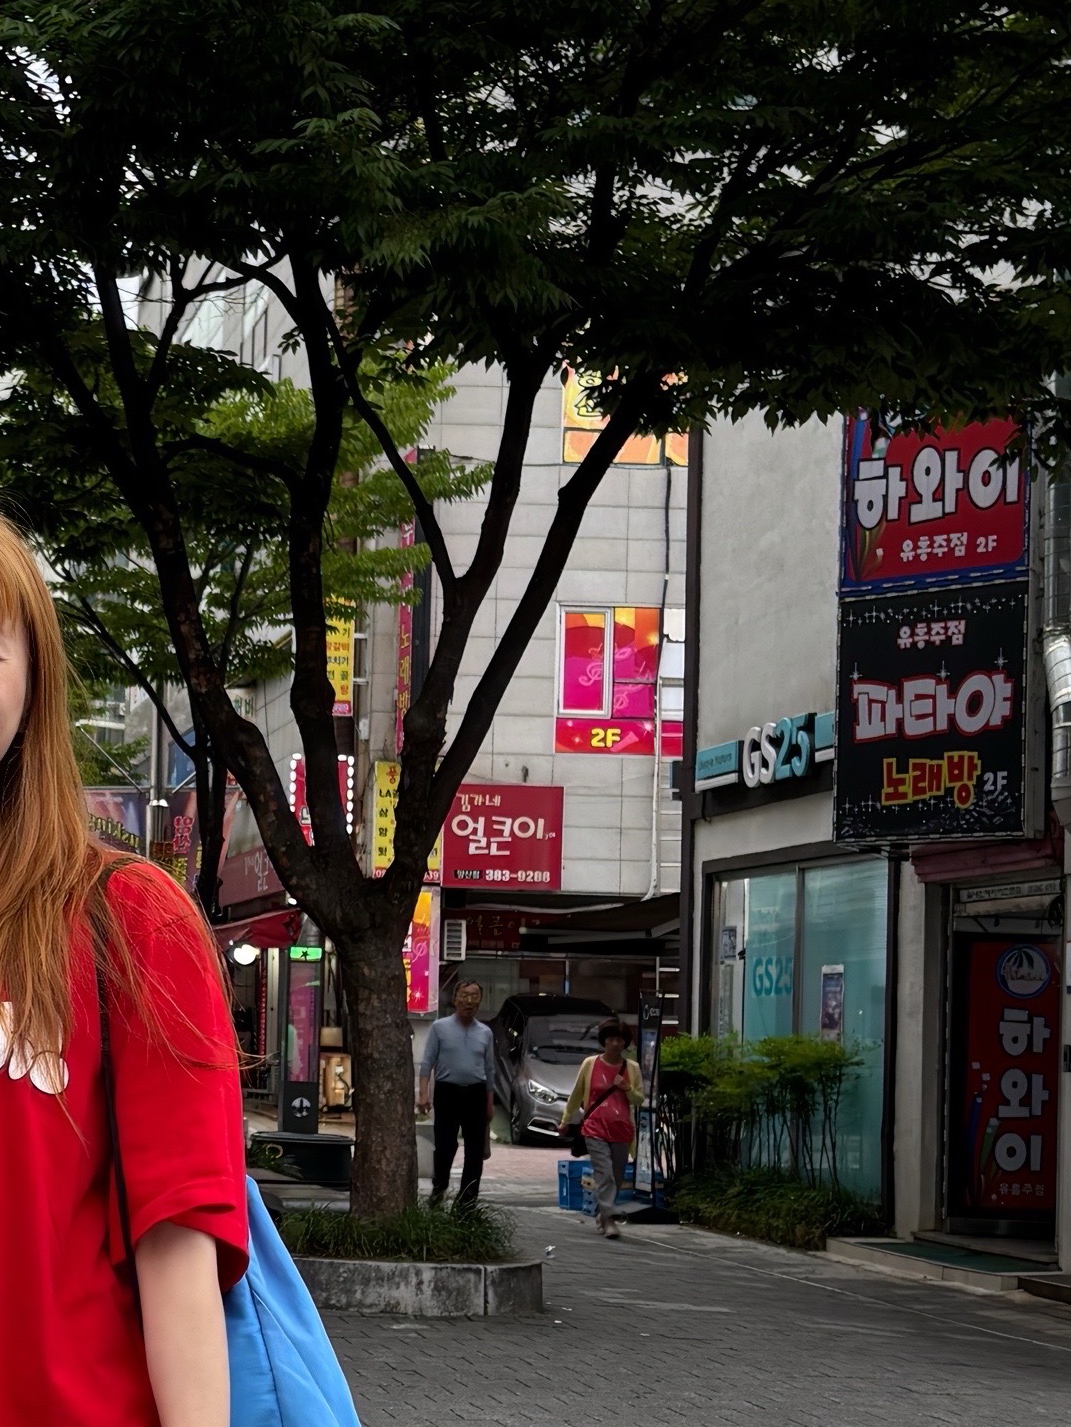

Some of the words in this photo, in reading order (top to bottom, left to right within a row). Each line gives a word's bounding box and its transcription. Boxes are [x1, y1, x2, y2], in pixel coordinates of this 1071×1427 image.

[854, 447, 1020, 529] 하와이
[900, 532, 968, 562] 유흥주점
[976, 535, 997, 553] 2F
[897, 619, 967, 650] 유흥주점
[852, 671, 1014, 743] 파타야
[590, 728, 622, 748] 2F
[742, 717, 810, 788] GS25
[881, 750, 981, 809] 노래방
[983, 771, 1008, 798] 2F
[451, 814, 545, 855] 얼큰이
[752, 956, 793, 997] GS25
[994, 1008, 1051, 1172] 하와이
